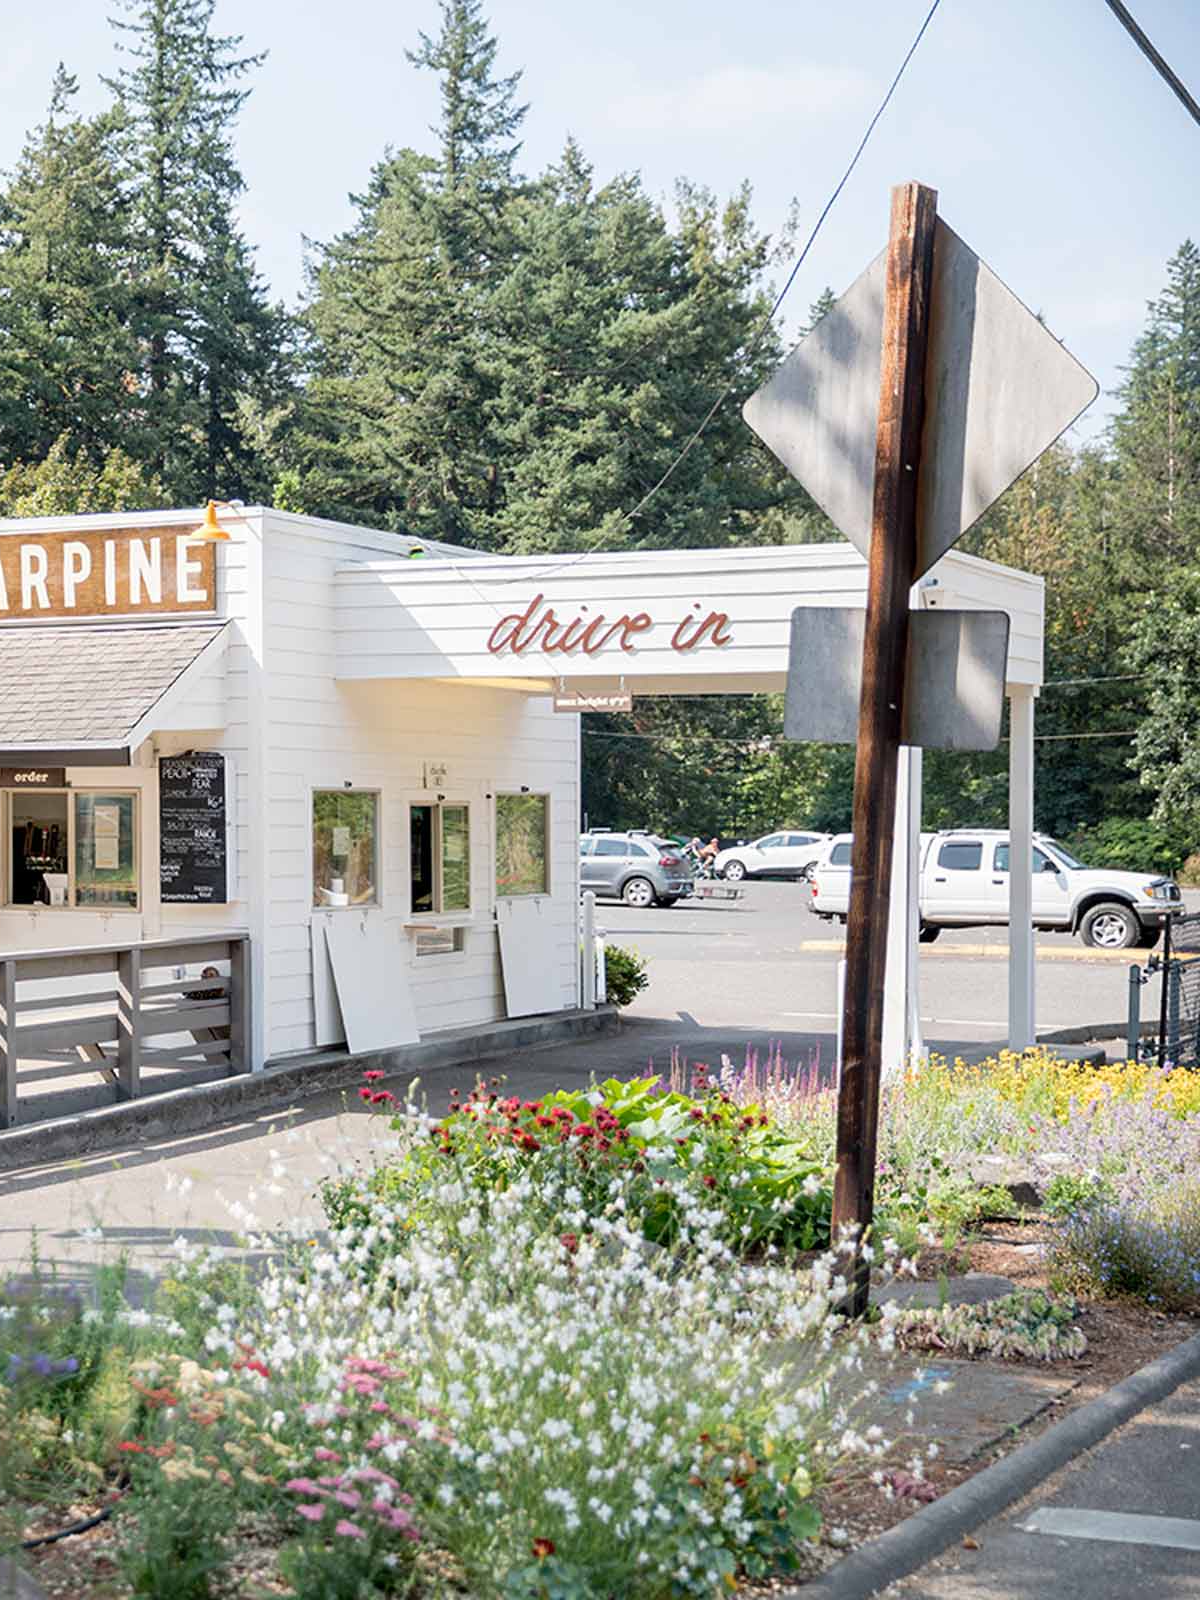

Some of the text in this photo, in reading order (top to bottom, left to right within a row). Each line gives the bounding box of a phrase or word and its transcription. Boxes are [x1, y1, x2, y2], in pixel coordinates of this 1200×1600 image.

[487, 593, 732, 655] drive in
[14, 771, 49, 782] order
